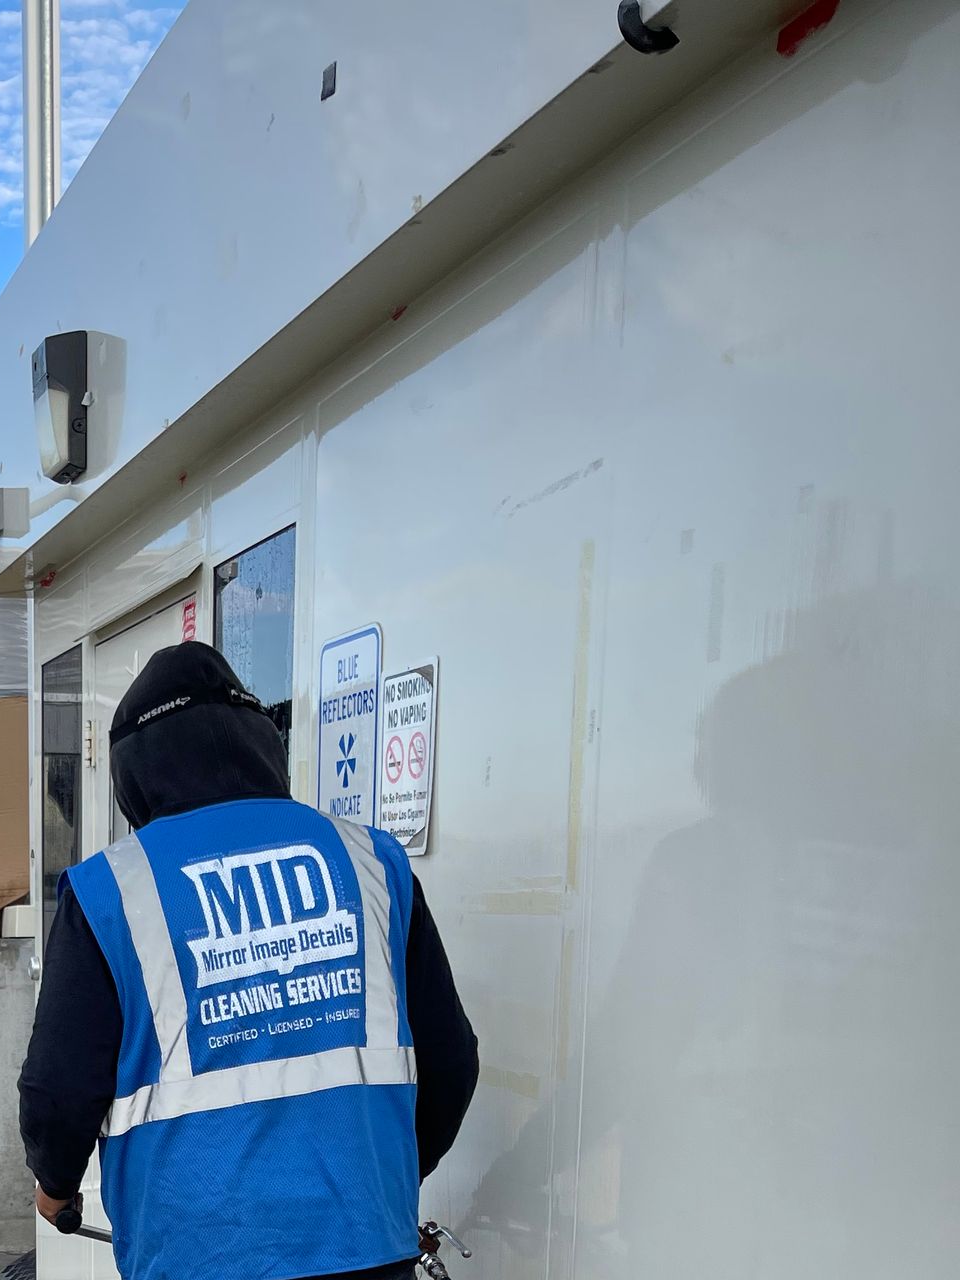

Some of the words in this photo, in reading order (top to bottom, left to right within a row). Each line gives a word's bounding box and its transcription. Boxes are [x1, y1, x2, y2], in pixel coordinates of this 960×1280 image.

[337, 655, 359, 684] BLUE
[385, 684, 396, 705] NO
[397, 677, 431, 701] SMOKING
[137, 700, 176, 725] HUSKY
[322, 688, 374, 725] REFLECTORS
[388, 709, 398, 729] NO
[399, 702, 427, 726] VAPING
[329, 794, 361, 817] INDICATE
[200, 855, 330, 940] MID
[202, 947, 247, 973] Mirror
[250, 936, 297, 961] Image
[298, 923, 354, 952] Details
[199, 983, 284, 1026] CLEANING
[285, 968, 361, 1007] SERVICES
